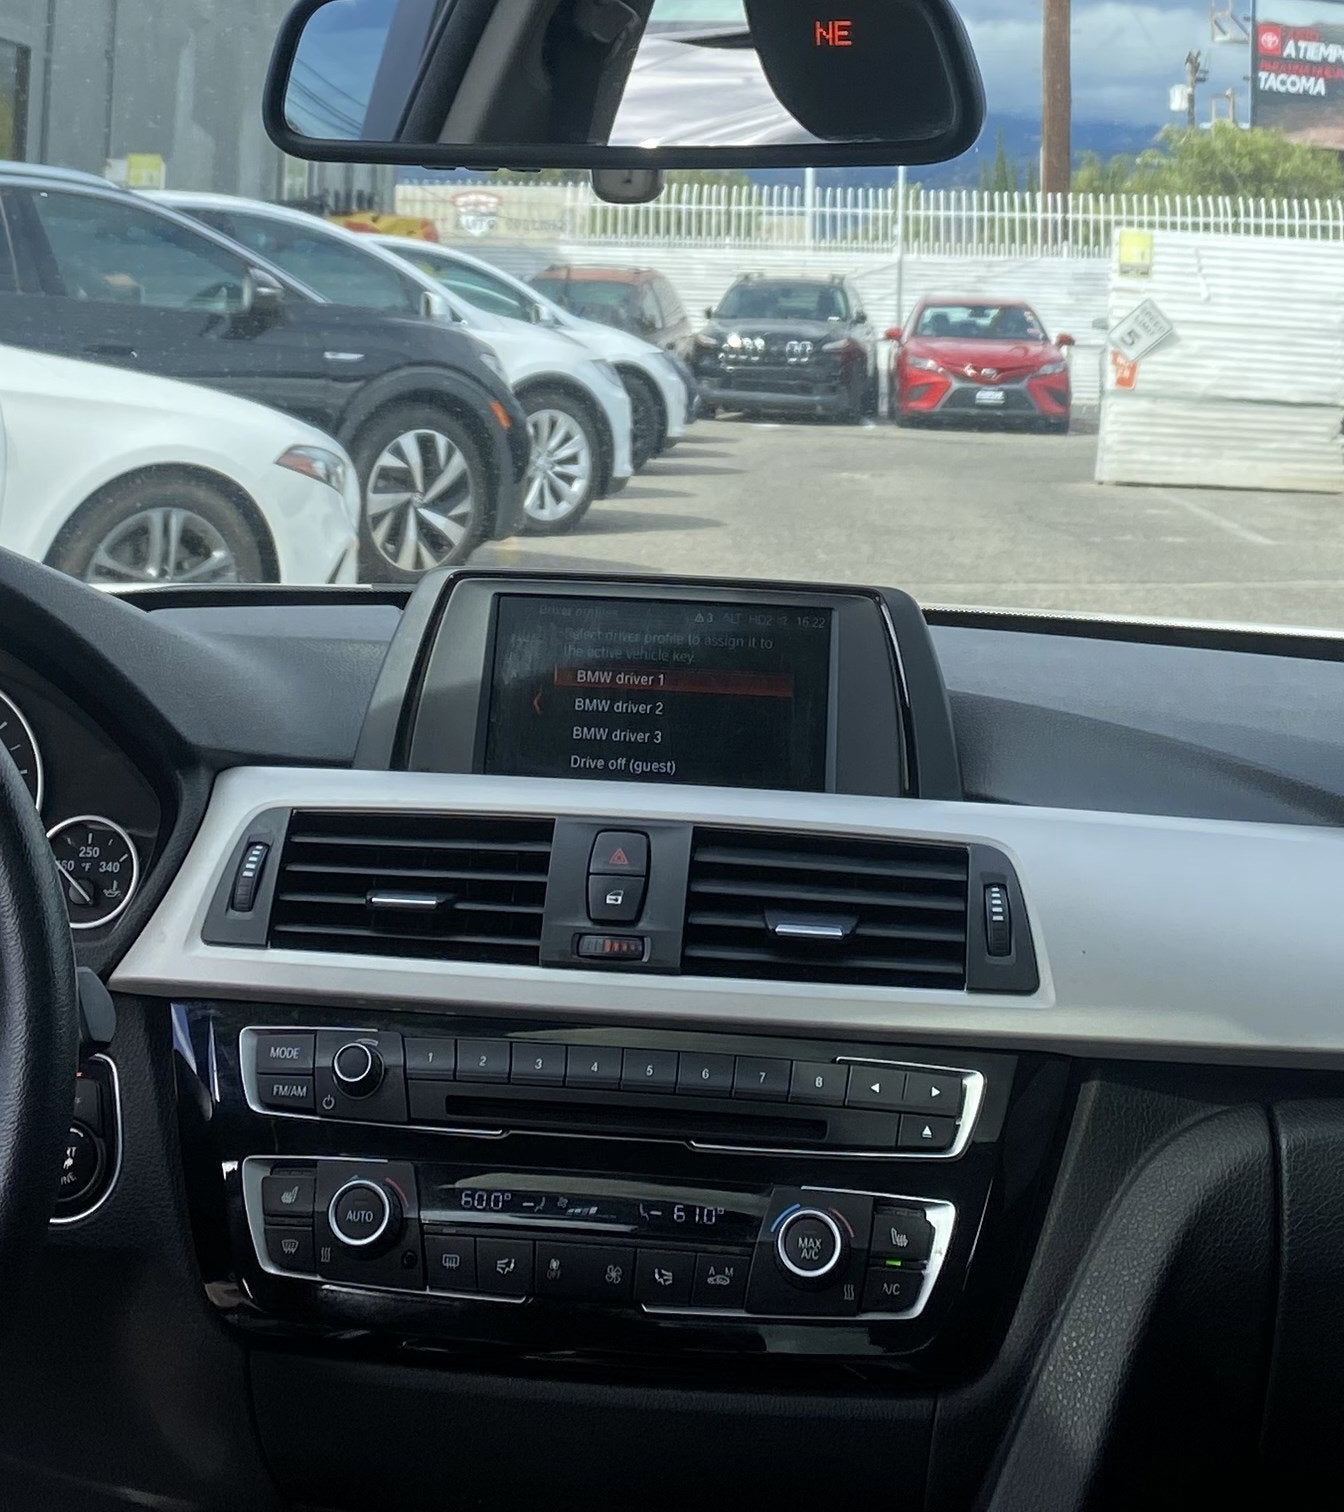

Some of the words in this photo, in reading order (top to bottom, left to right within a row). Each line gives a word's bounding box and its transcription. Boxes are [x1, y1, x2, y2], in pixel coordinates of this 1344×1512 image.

[816, 21, 852, 45] NE
[1283, 40, 1296, 58] A
[1258, 71, 1327, 97] TACOMA
[1121, 330, 1140, 347] 5
[644, 633, 683, 646] profile
[704, 635, 744, 649] assign
[748, 635, 756, 648] it
[760, 637, 773, 649] to
[586, 646, 623, 658] active
[626, 647, 670, 661] vehicle
[577, 670, 612, 683] BMW
[616, 672, 654, 686] driver
[658, 674, 664, 686] 1
[575, 698, 610, 712] BMW
[614, 700, 653, 714] driver
[655, 702, 664, 715] 2
[573, 727, 608, 740] BMW
[612, 729, 650, 743] driver
[653, 731, 662, 743] 3
[570, 755, 605, 769] Drive
[608, 757, 626, 770] off
[629, 758, 676, 775] (guest)
[79, 846, 100, 858] 250
[99, 862, 120, 873] 340
[270, 1045, 300, 1060] MODE
[427, 1052, 434, 1062] 1
[479, 1056, 486, 1067] 2
[535, 1059, 542, 1070] 3
[591, 1061, 599, 1072] 4
[646, 1064, 654, 1076] 5
[702, 1068, 709, 1080] 6
[759, 1072, 767, 1083] 7
[815, 1076, 823, 1088] 8
[272, 1084, 307, 1098] FM/AM
[345, 1210, 373, 1223] AUTO
[798, 1237, 822, 1250] MAX
[800, 1248, 820, 1261] A/C
[708, 1266, 715, 1276] A
[724, 1266, 734, 1277] M
[882, 1283, 900, 1296] A/C
